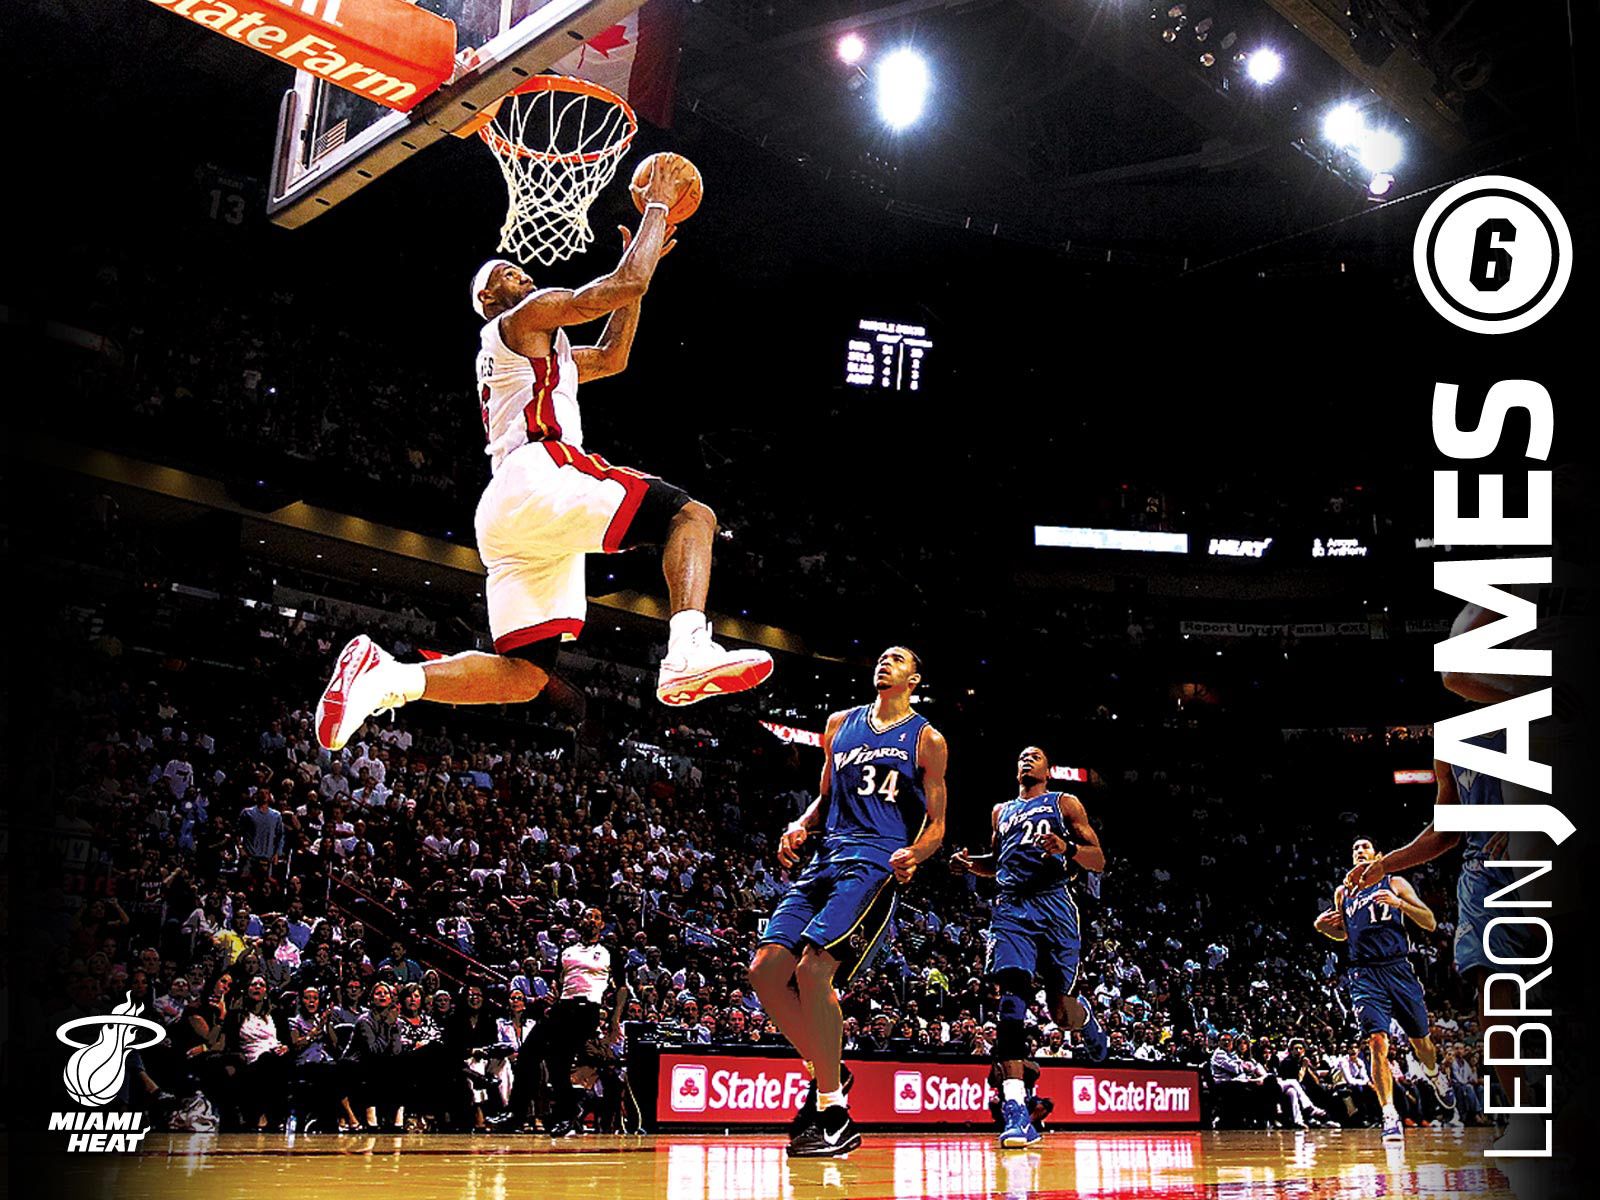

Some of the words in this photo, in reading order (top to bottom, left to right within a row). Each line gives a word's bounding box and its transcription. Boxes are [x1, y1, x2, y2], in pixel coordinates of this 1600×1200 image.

[277, 34, 417, 104] Farm
[857, 764, 899, 803] 34
[1020, 819, 1051, 845] 20
[1367, 902, 1392, 924] 12
